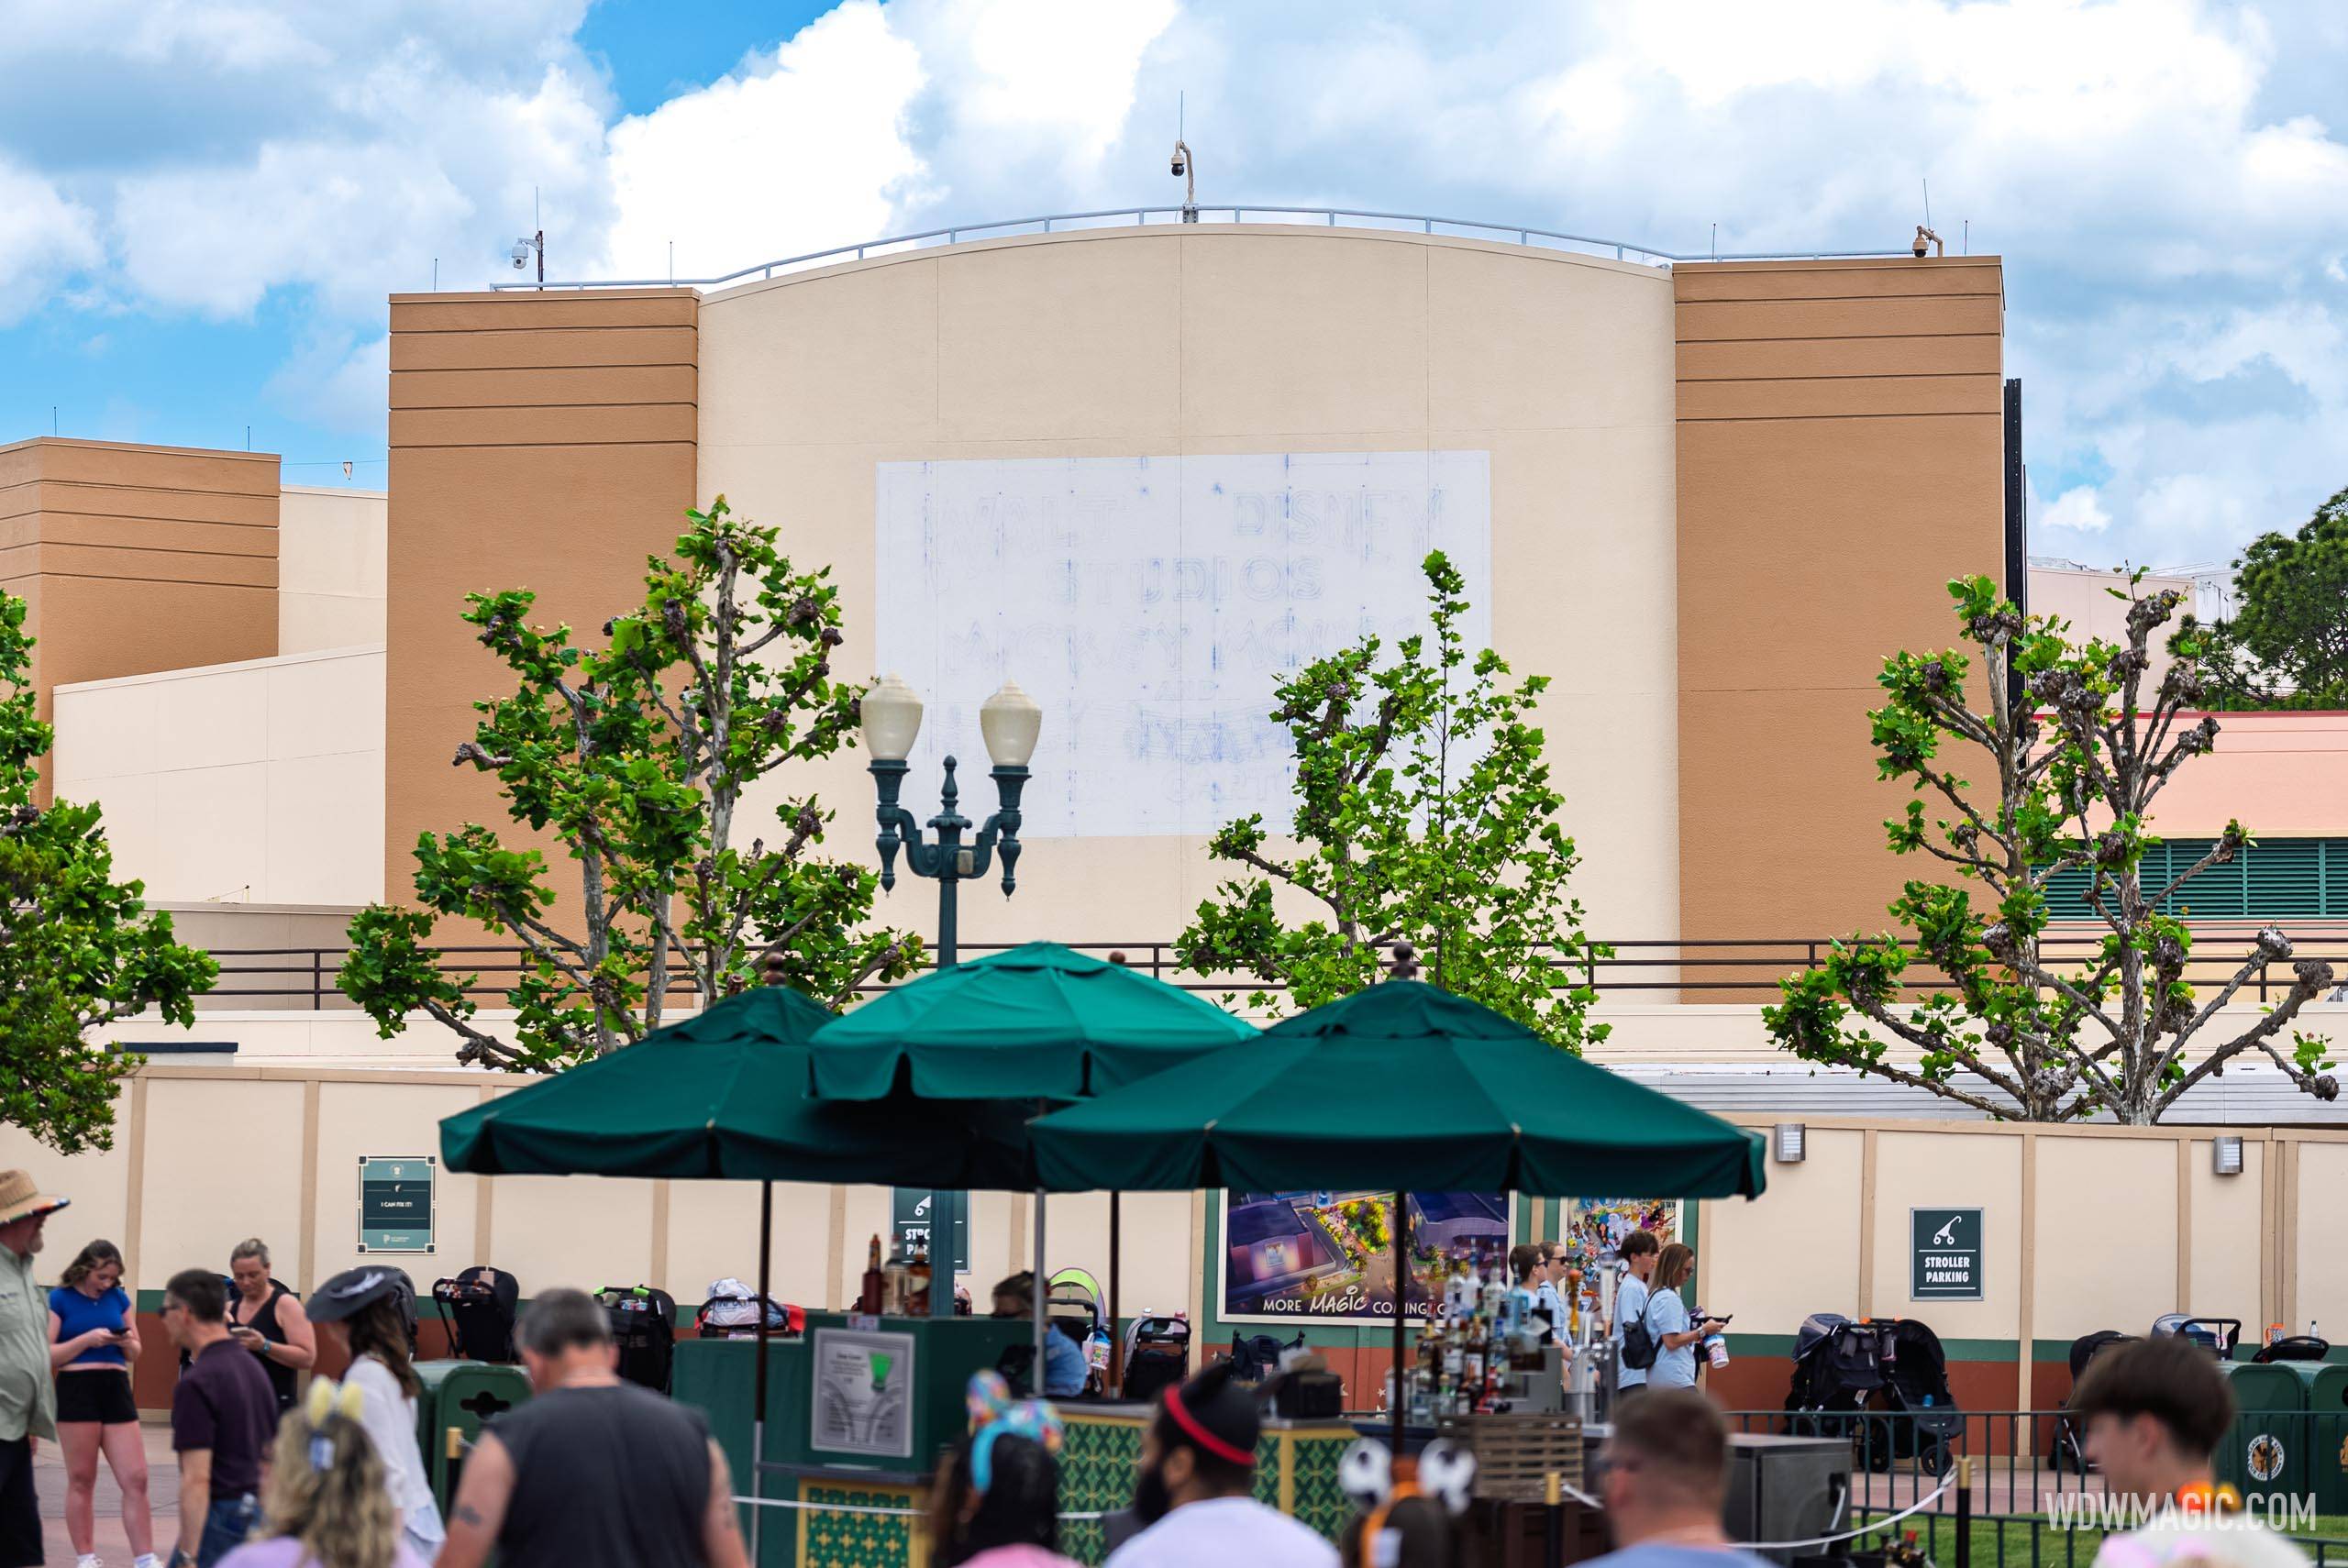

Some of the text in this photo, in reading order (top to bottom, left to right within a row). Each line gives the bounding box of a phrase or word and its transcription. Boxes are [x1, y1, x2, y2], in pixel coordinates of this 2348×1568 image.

[1233, 489, 1443, 570] DISNEY
[1041, 554, 1324, 605] STUDIOS
[945, 619, 1192, 676] MICKEY
[1153, 679, 1218, 701] AND
[905, 1228, 931, 1241] STRO
[1924, 1256, 1970, 1268] STROLLER
[1925, 1271, 1969, 1283] PARKING
[1263, 1298, 1302, 1312] MORE
[1309, 1286, 1368, 1313] MAGIC
